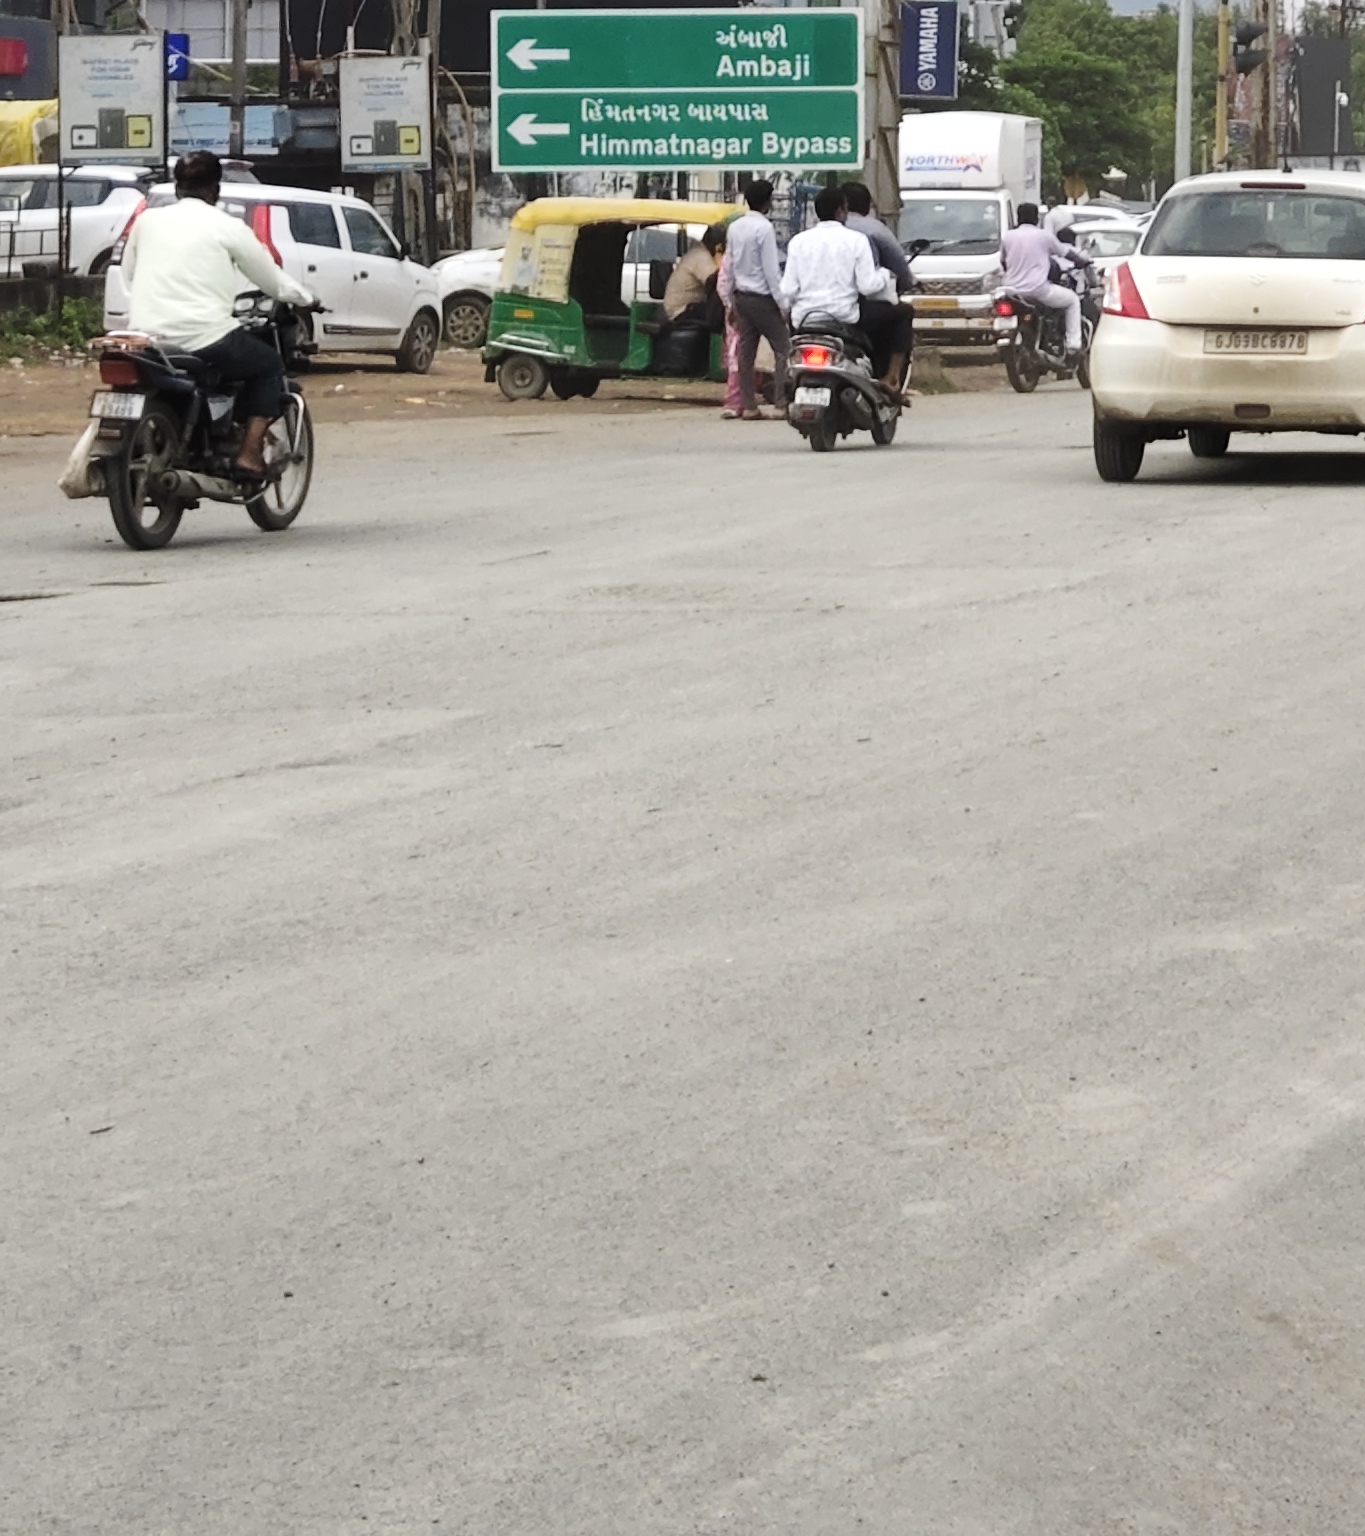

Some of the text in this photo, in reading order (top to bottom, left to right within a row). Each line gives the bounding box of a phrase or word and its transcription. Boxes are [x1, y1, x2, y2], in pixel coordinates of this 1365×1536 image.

[716, 24, 788, 49] અંબાજી
[918, 6, 939, 72] YAMAHA
[716, 54, 810, 80] Ambaji
[581, 98, 769, 122] હિંમતનગર બાયપાસ
[580, 132, 852, 159] Himmatnagar Bypass
